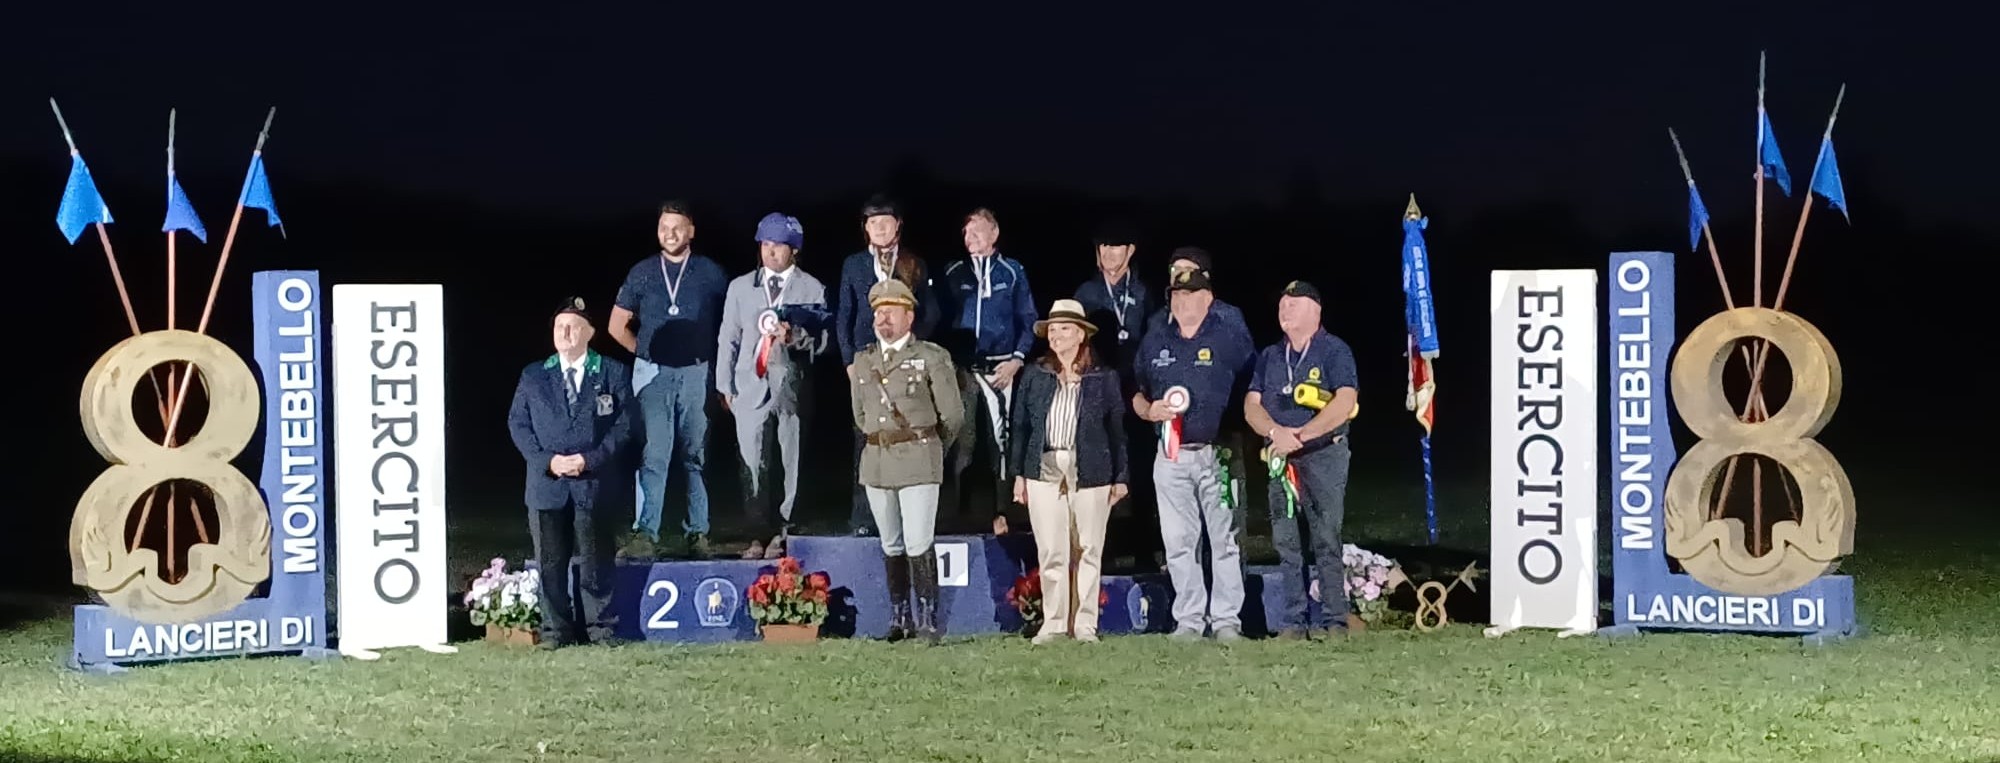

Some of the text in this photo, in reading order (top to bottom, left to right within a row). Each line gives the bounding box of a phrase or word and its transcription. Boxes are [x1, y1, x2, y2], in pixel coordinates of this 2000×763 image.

[69, 329, 272, 622] 8
[277, 278, 317, 574] MONTEBELLO
[370, 301, 421, 604] ESERCITO
[1517, 285, 1565, 584] ESERCITO
[1617, 259, 1653, 550] MONTEBELLO
[1664, 306, 1856, 596] 8
[105, 616, 313, 657] LANCIERI DI
[647, 580, 679, 630] 2
[938, 551, 952, 579] 1
[1416, 581, 1447, 631] 8
[1627, 594, 1825, 626] LANCIERI DI
